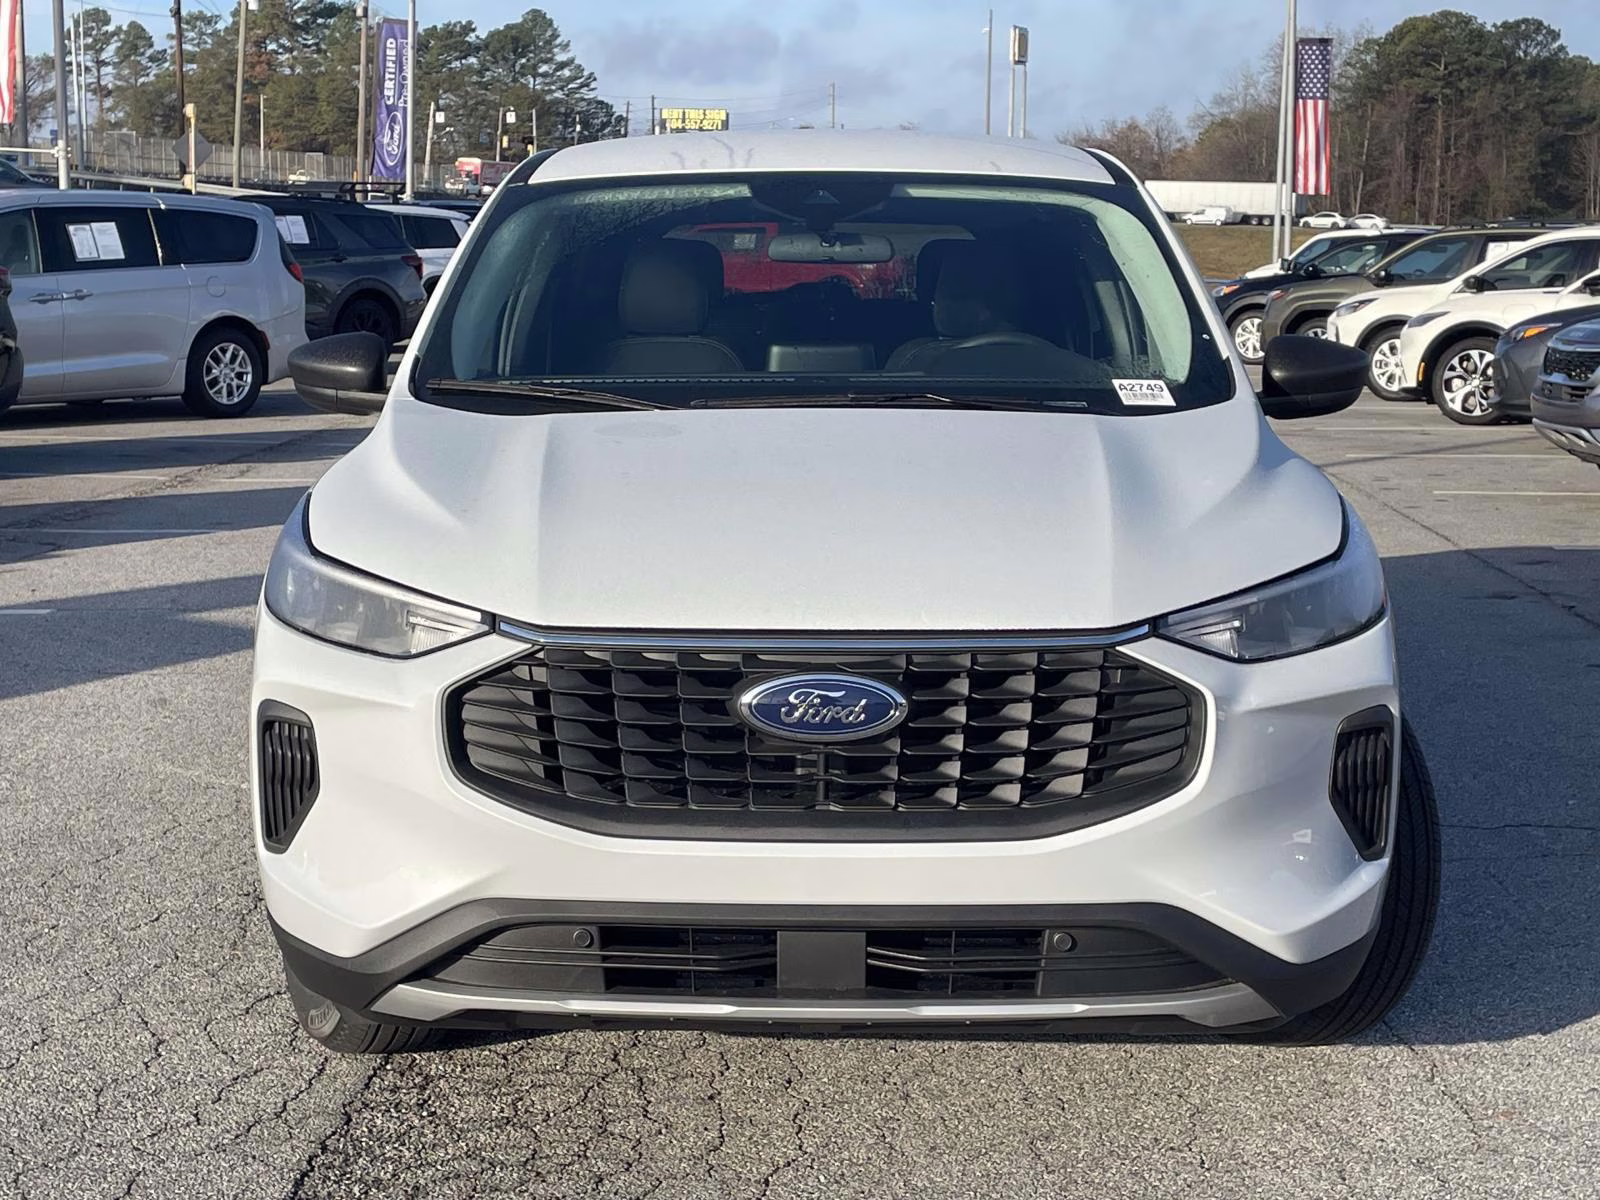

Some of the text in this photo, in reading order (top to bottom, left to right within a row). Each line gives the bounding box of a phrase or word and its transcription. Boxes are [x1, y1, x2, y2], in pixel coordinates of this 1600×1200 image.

[384, 38, 397, 105] CERTIFIED
[384, 121, 401, 155] Ford
[1118, 383, 1164, 393] A2749
[780, 688, 868, 724] Ford
